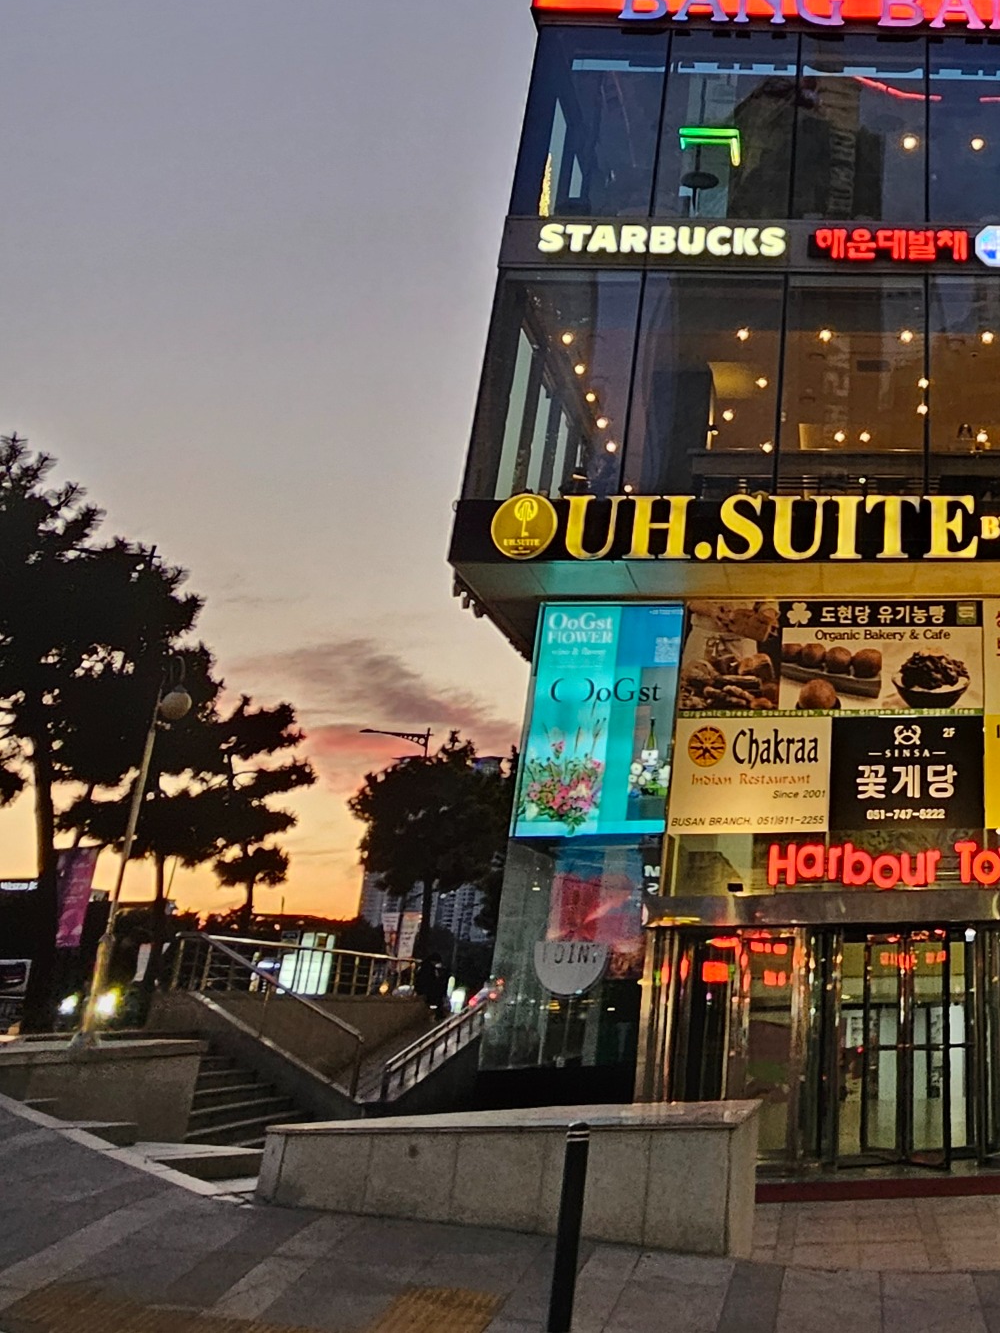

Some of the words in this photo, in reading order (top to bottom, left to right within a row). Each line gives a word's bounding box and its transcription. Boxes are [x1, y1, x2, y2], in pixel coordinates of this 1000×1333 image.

[537, 222, 787, 258] STARBUCKS
[563, 494, 978, 560] UH.SUITE
[820, 605, 871, 624] 도현당
[877, 605, 946, 624] 유기농빵
[815, 629, 860, 642] Organic
[864, 630, 906, 642] Bakery
[909, 630, 920, 640] &
[923, 629, 951, 640] Cafe
[683, 710, 721, 718] Organic
[942, 727, 956, 738] 2F
[732, 727, 819, 769] Chakraa
[885, 748, 930, 758] SINSA
[691, 773, 732, 786] Indian
[739, 773, 811, 785] Restaurant
[856, 764, 958, 799] 꽃게당
[772, 789, 799, 799] Since
[802, 789, 826, 799] 2001
[671, 817, 705, 827] BUSAN
[757, 815, 825, 826] 051)911-2255
[768, 841, 940, 888] Harbour
